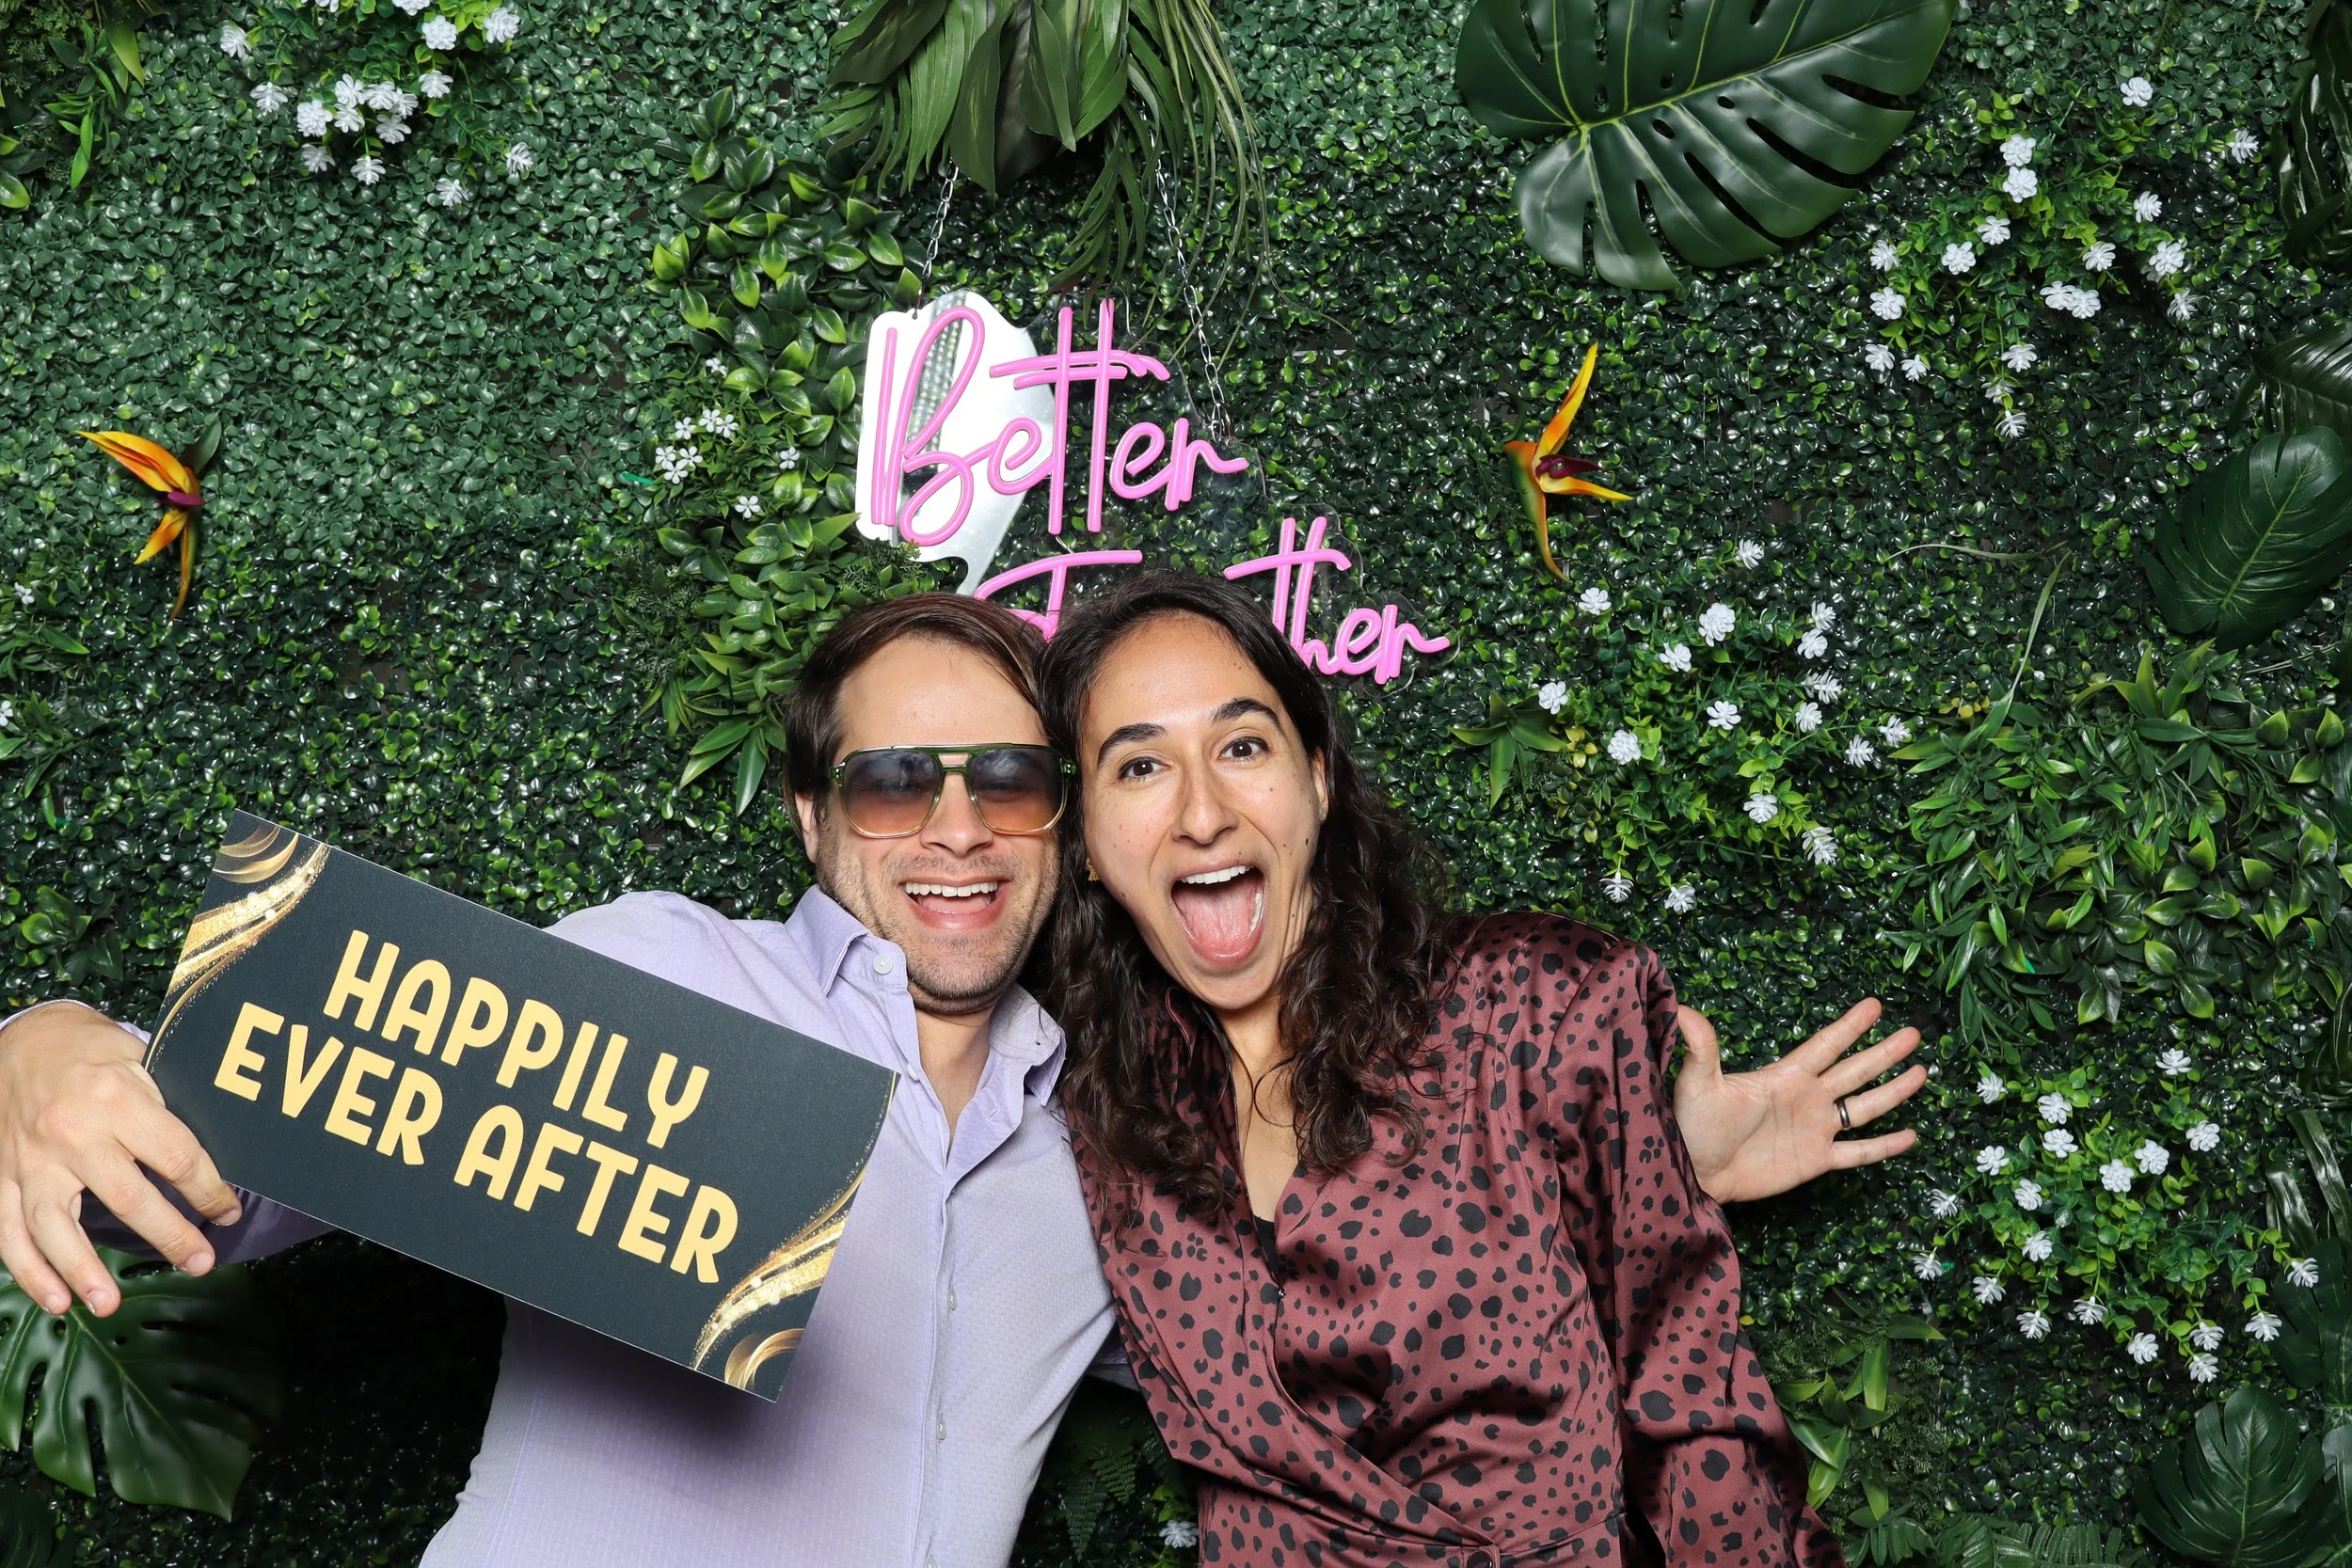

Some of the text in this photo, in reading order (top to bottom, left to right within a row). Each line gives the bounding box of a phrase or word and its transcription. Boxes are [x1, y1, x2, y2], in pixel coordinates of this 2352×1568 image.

[871, 298, 1248, 546] Better
[974, 516, 1450, 684] Tther
[213, 1002, 739, 1284] EVER AFTER
[323, 929, 710, 1148] HAPPILY
